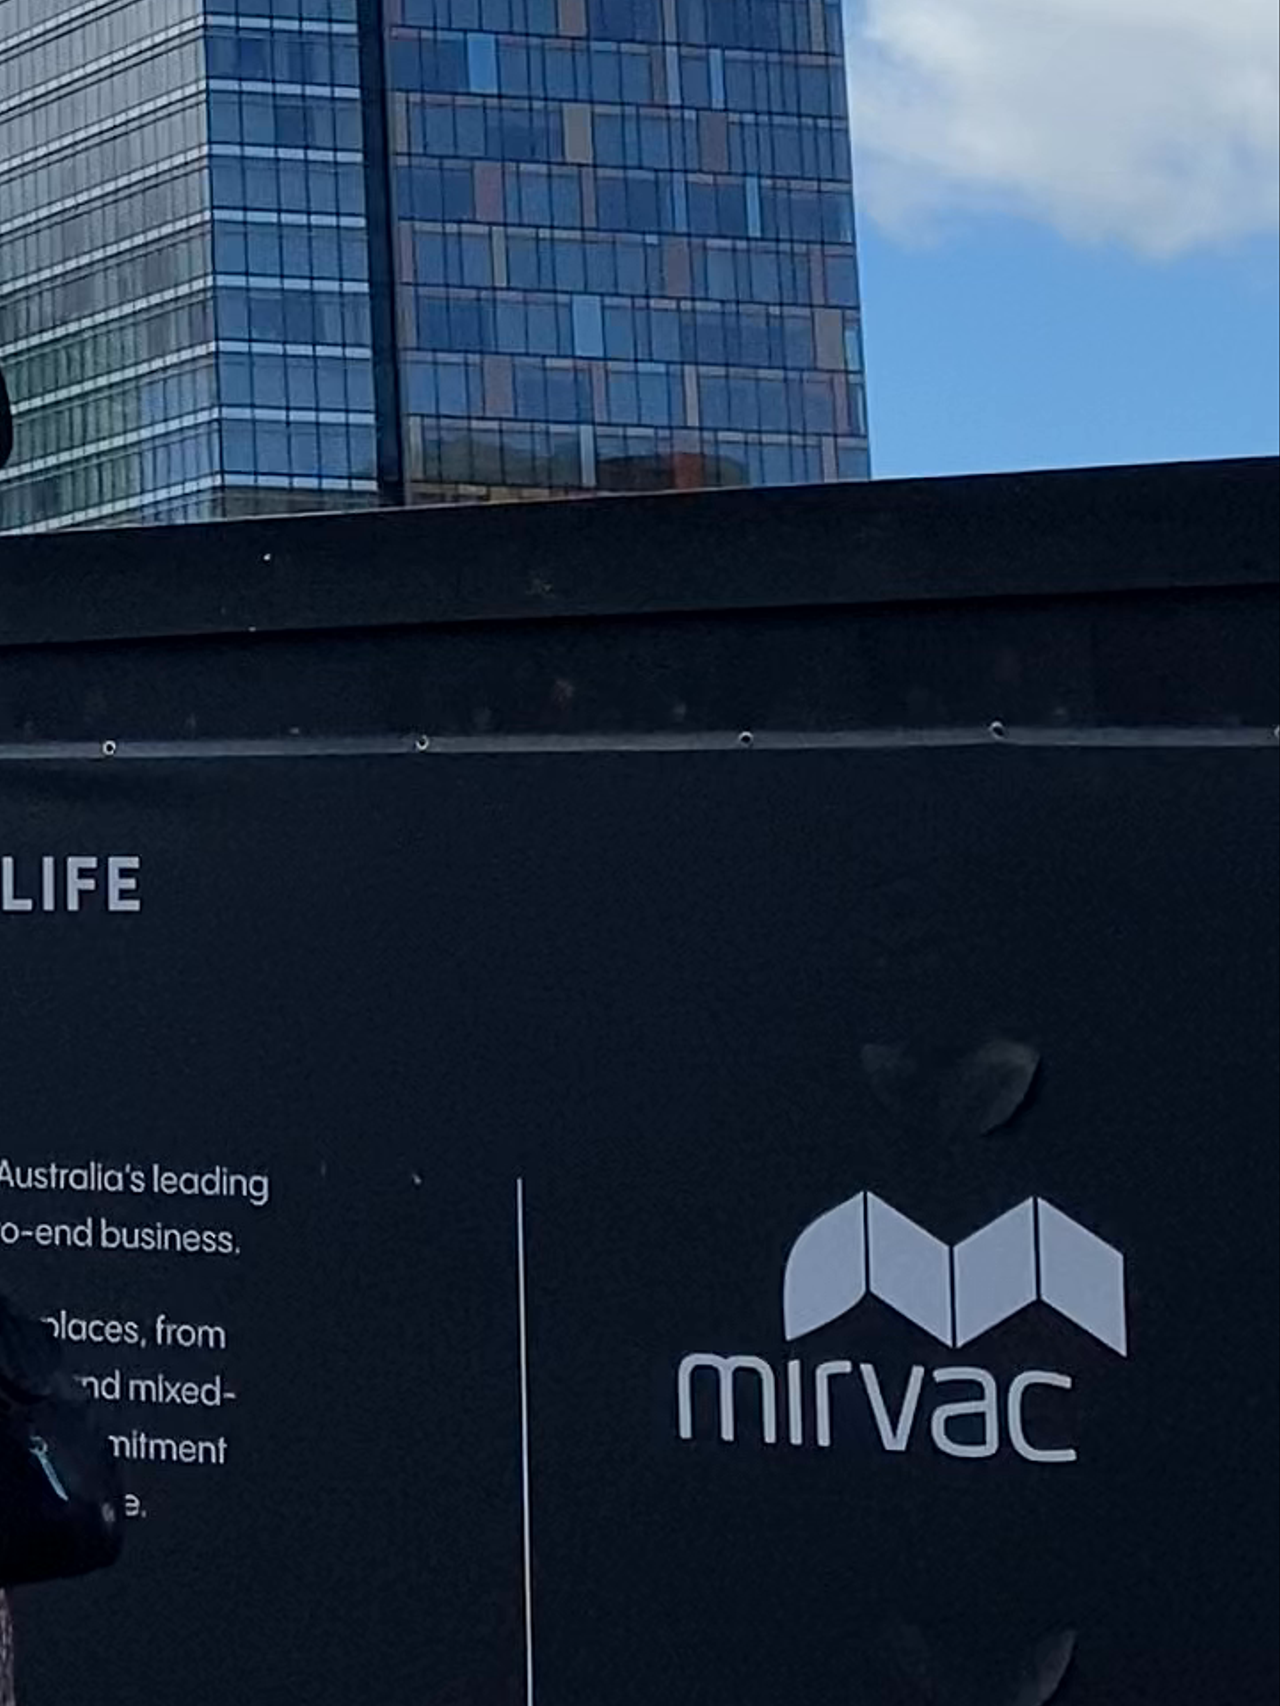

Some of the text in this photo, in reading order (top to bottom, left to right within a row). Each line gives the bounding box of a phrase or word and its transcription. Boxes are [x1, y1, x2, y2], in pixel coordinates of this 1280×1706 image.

[2, 856, 142, 912] LIFE
[152, 1162, 270, 1207] leading
[99, 1216, 241, 1255] business.
[155, 1313, 227, 1350] from
[74, 1368, 121, 1401] nd
[128, 1373, 237, 1407] mixed-
[676, 1351, 1078, 1463] mirvac
